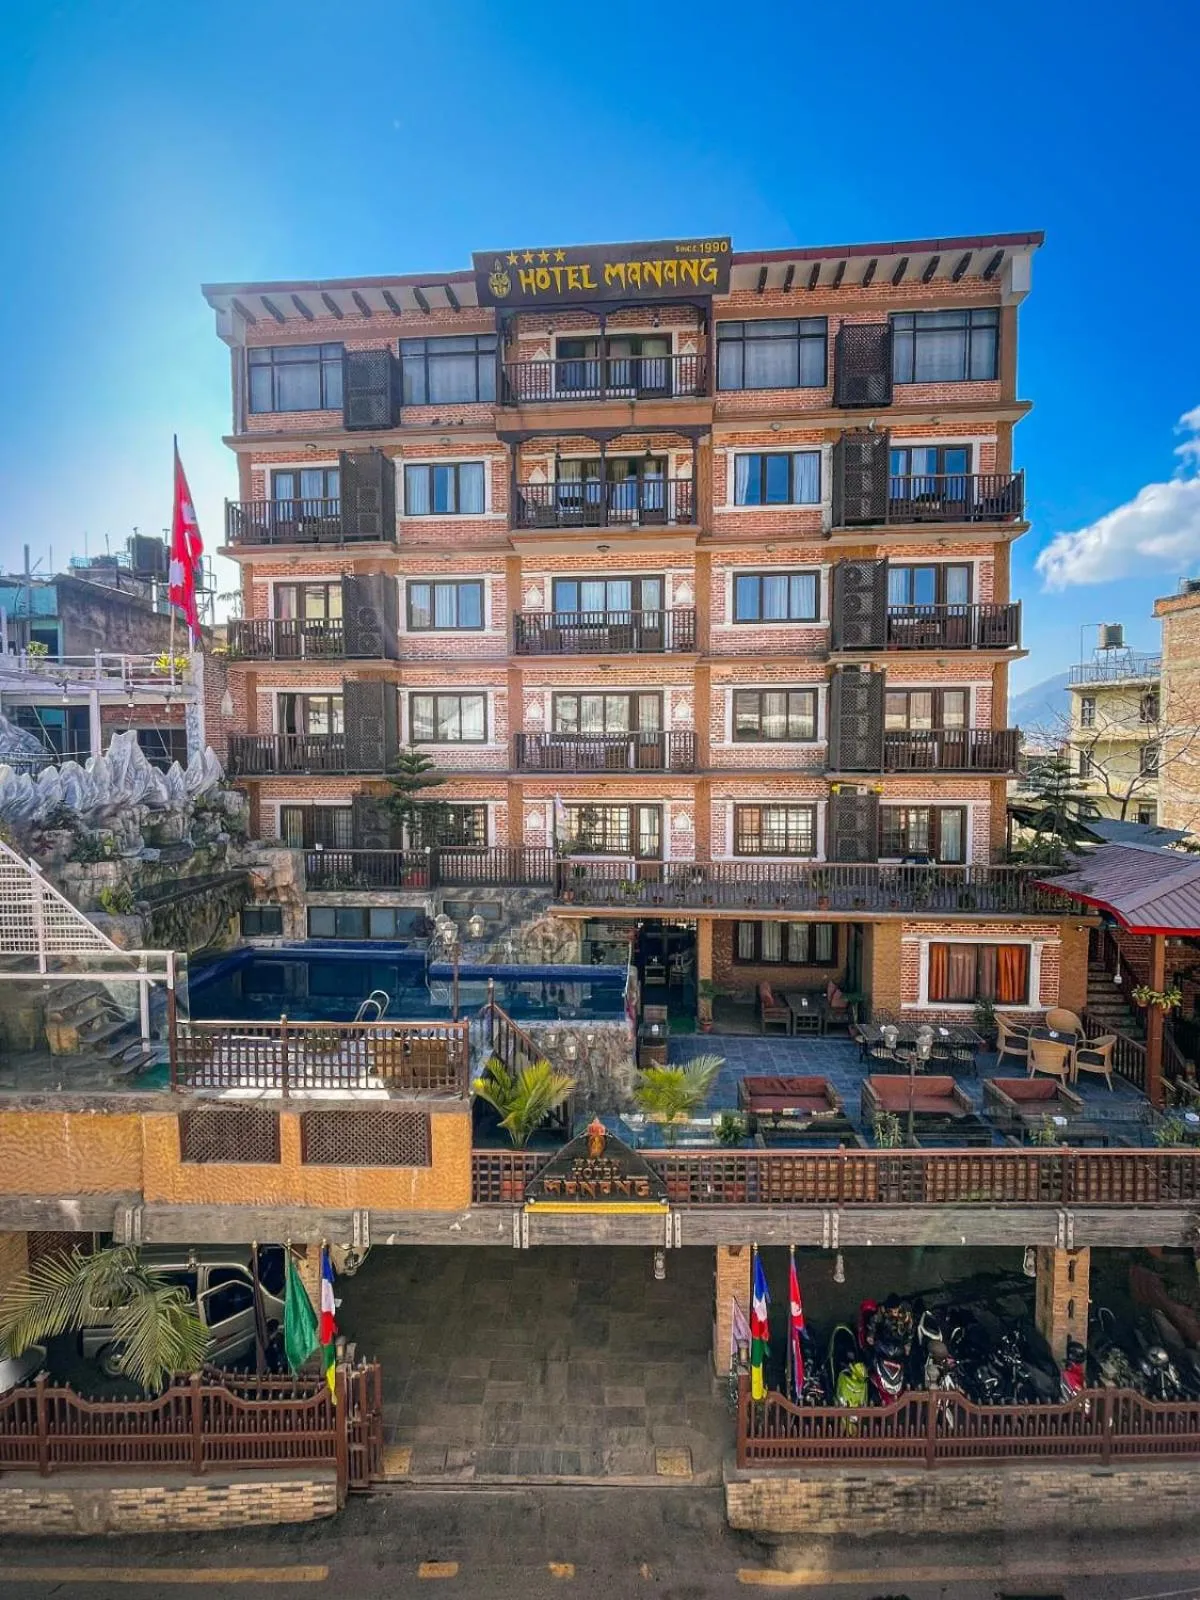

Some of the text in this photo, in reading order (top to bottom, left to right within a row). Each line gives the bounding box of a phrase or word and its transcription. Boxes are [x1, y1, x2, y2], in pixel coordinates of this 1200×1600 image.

[700, 241, 728, 254] 1990
[518, 258, 718, 296] HOTEL MANANG
[572, 1167, 620, 1179] HOTEL
